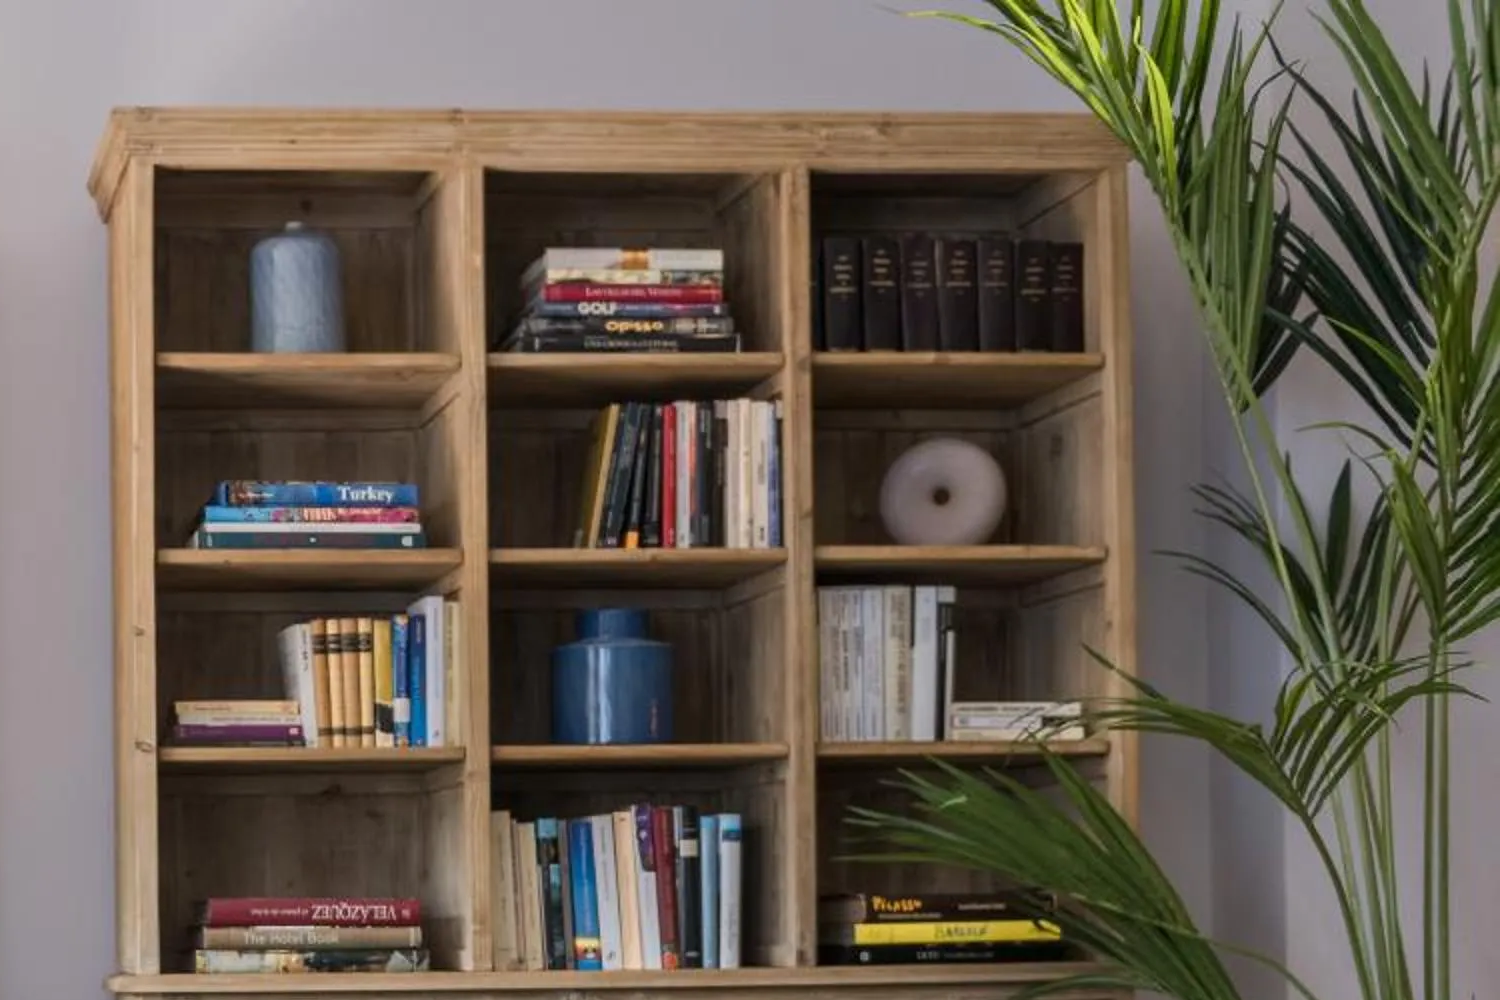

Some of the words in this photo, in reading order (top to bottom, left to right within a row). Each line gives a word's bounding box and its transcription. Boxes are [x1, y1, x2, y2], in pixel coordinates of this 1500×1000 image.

[577, 302, 618, 315] GOLF
[337, 485, 395, 503] Turkey
[311, 902, 397, 923] VELÁZQUEZ
